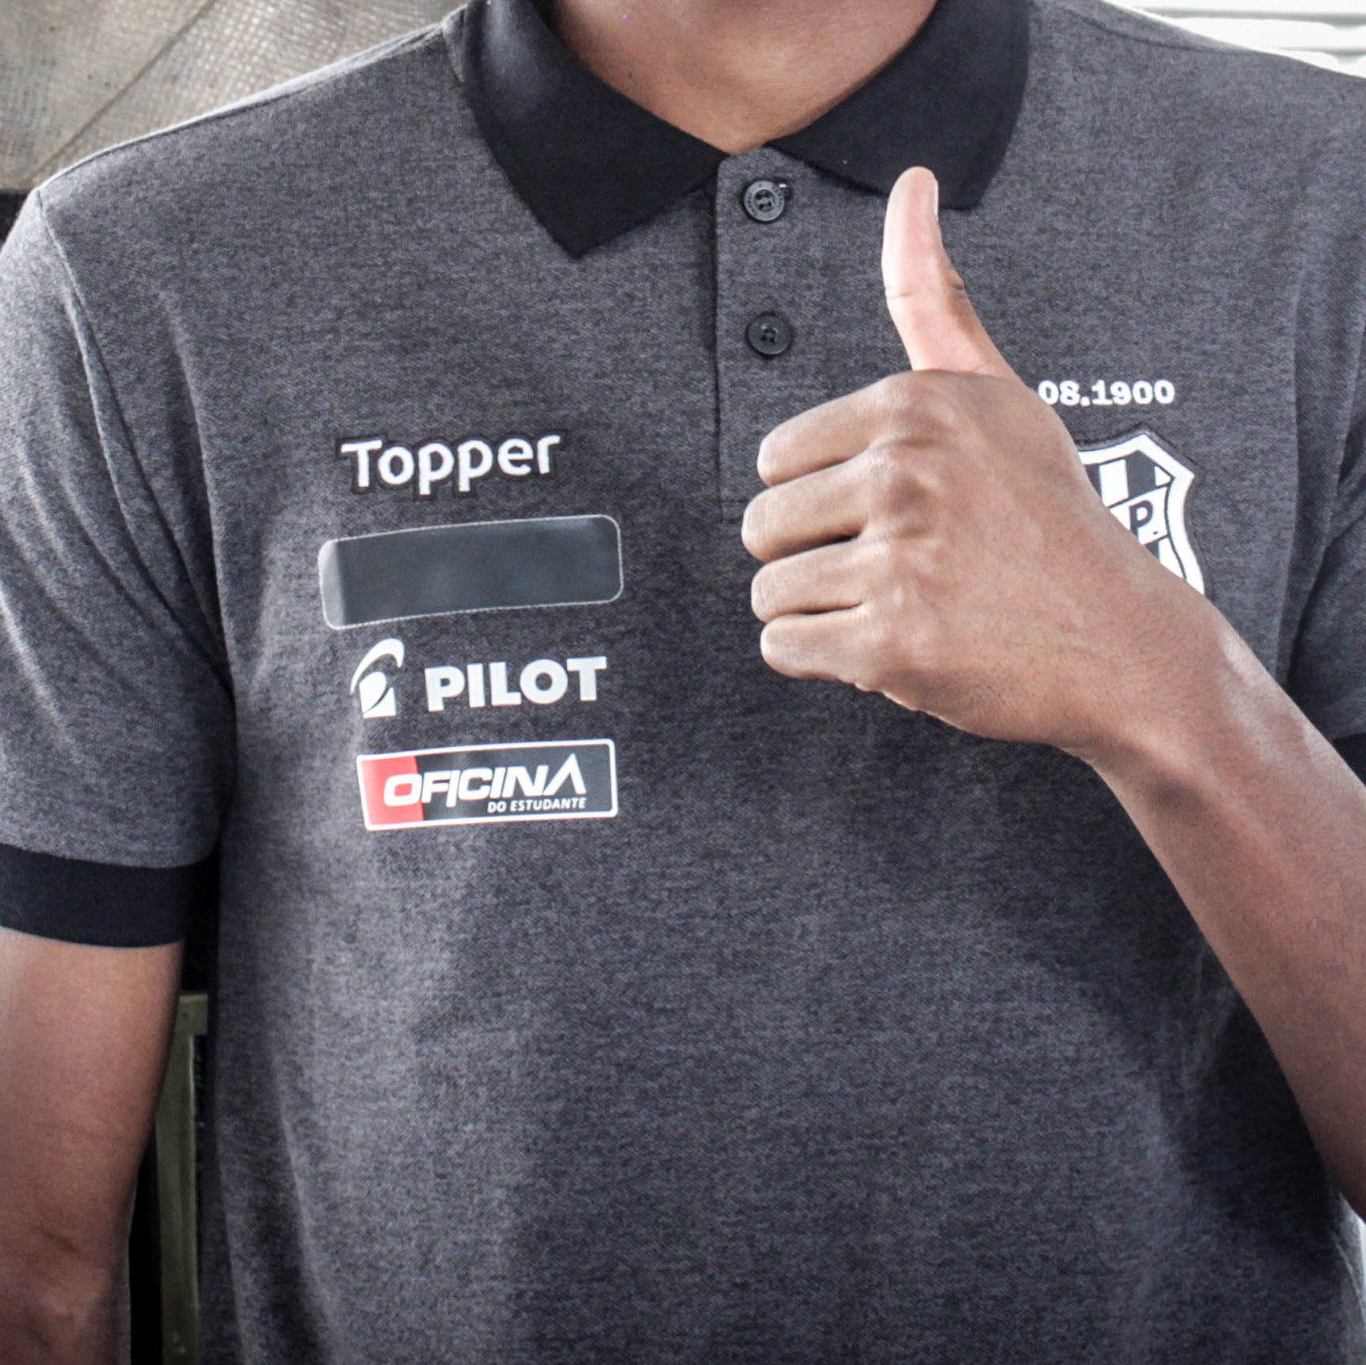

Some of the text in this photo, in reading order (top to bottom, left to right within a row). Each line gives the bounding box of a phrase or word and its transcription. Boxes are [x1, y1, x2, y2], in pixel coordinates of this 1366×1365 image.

[341, 435, 561, 495] Topper
[424, 656, 607, 712] PILOT
[383, 753, 588, 807] OFICINA
[487, 797, 588, 814] DO ESTUDANTE
